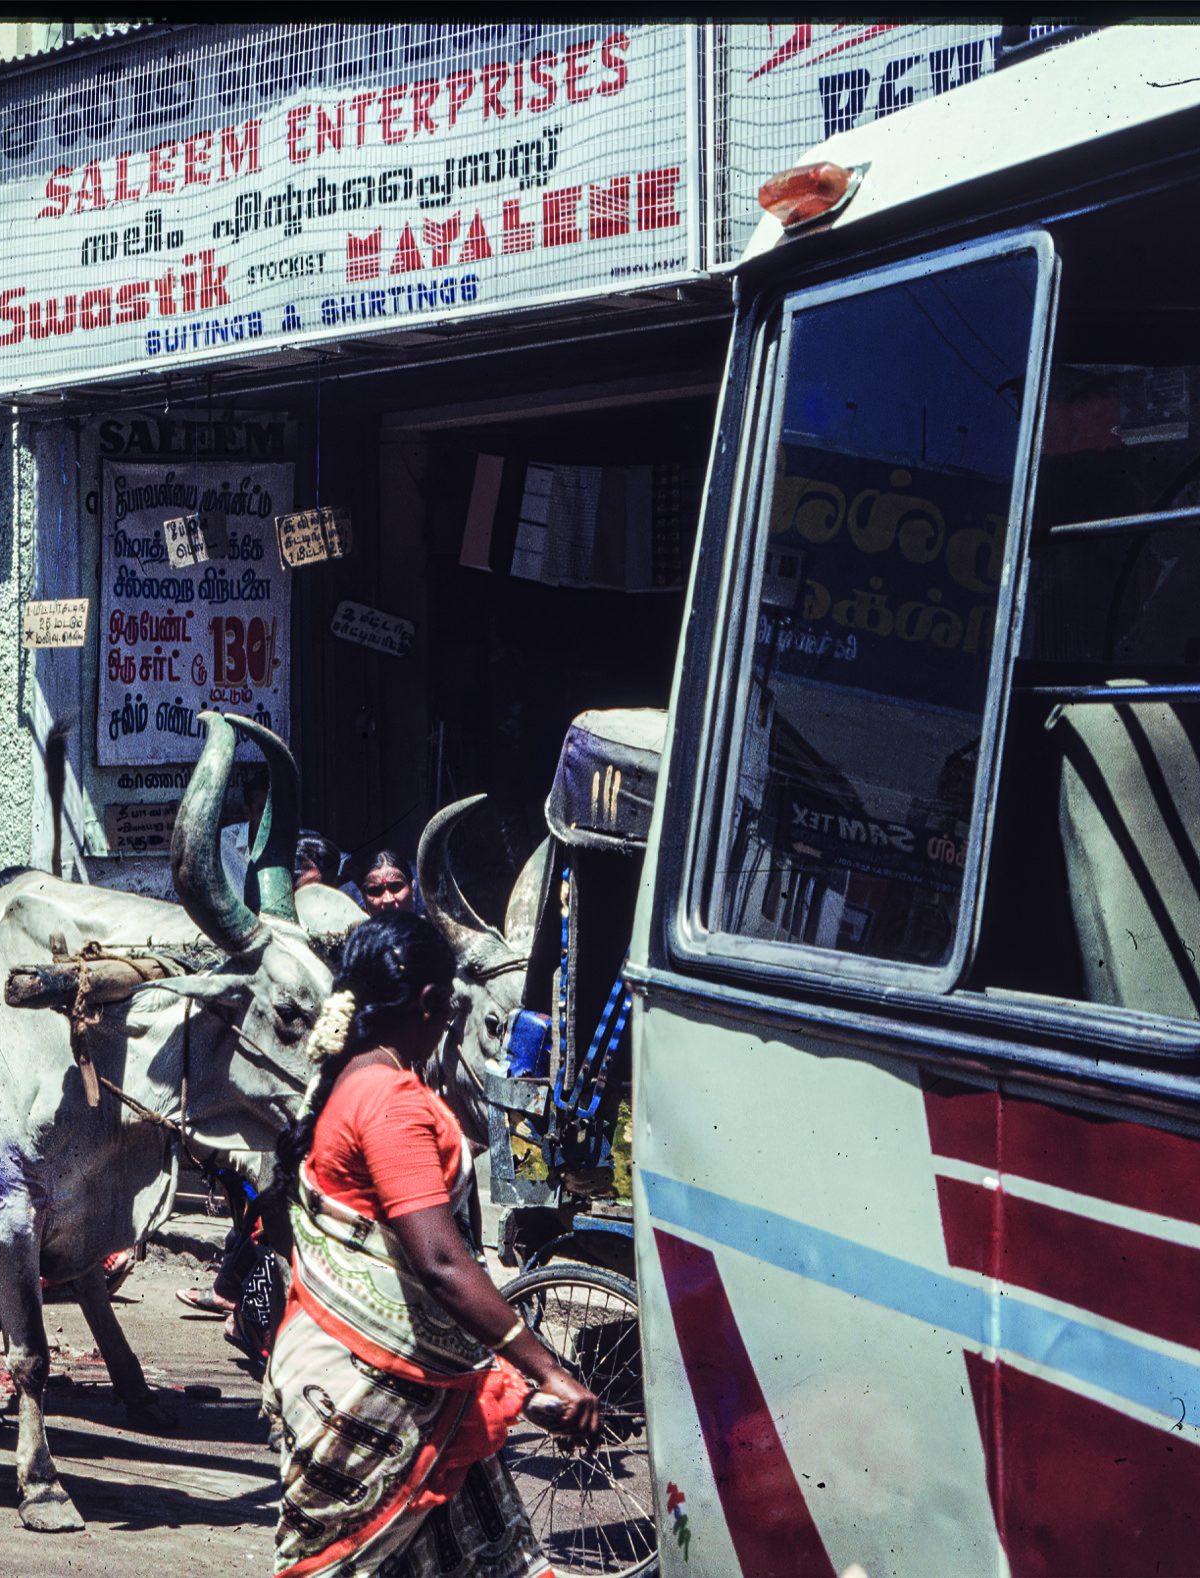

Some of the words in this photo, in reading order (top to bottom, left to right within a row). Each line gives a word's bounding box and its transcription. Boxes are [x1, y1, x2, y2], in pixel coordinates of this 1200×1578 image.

[35, 118, 263, 222] SALEEM
[285, 32, 630, 165] ENTERPRISES
[247, 252, 327, 284] STOCKIST
[345, 166, 681, 283] MAYALENE
[145, 310, 263, 356] SUITINGS
[281, 303, 302, 333] &
[320, 272, 481, 326] SHIRTINGS
[99, 420, 287, 456] SALEEM
[199, 567, 272, 604] விற்பனை
[107, 649, 137, 684] ஒரு
